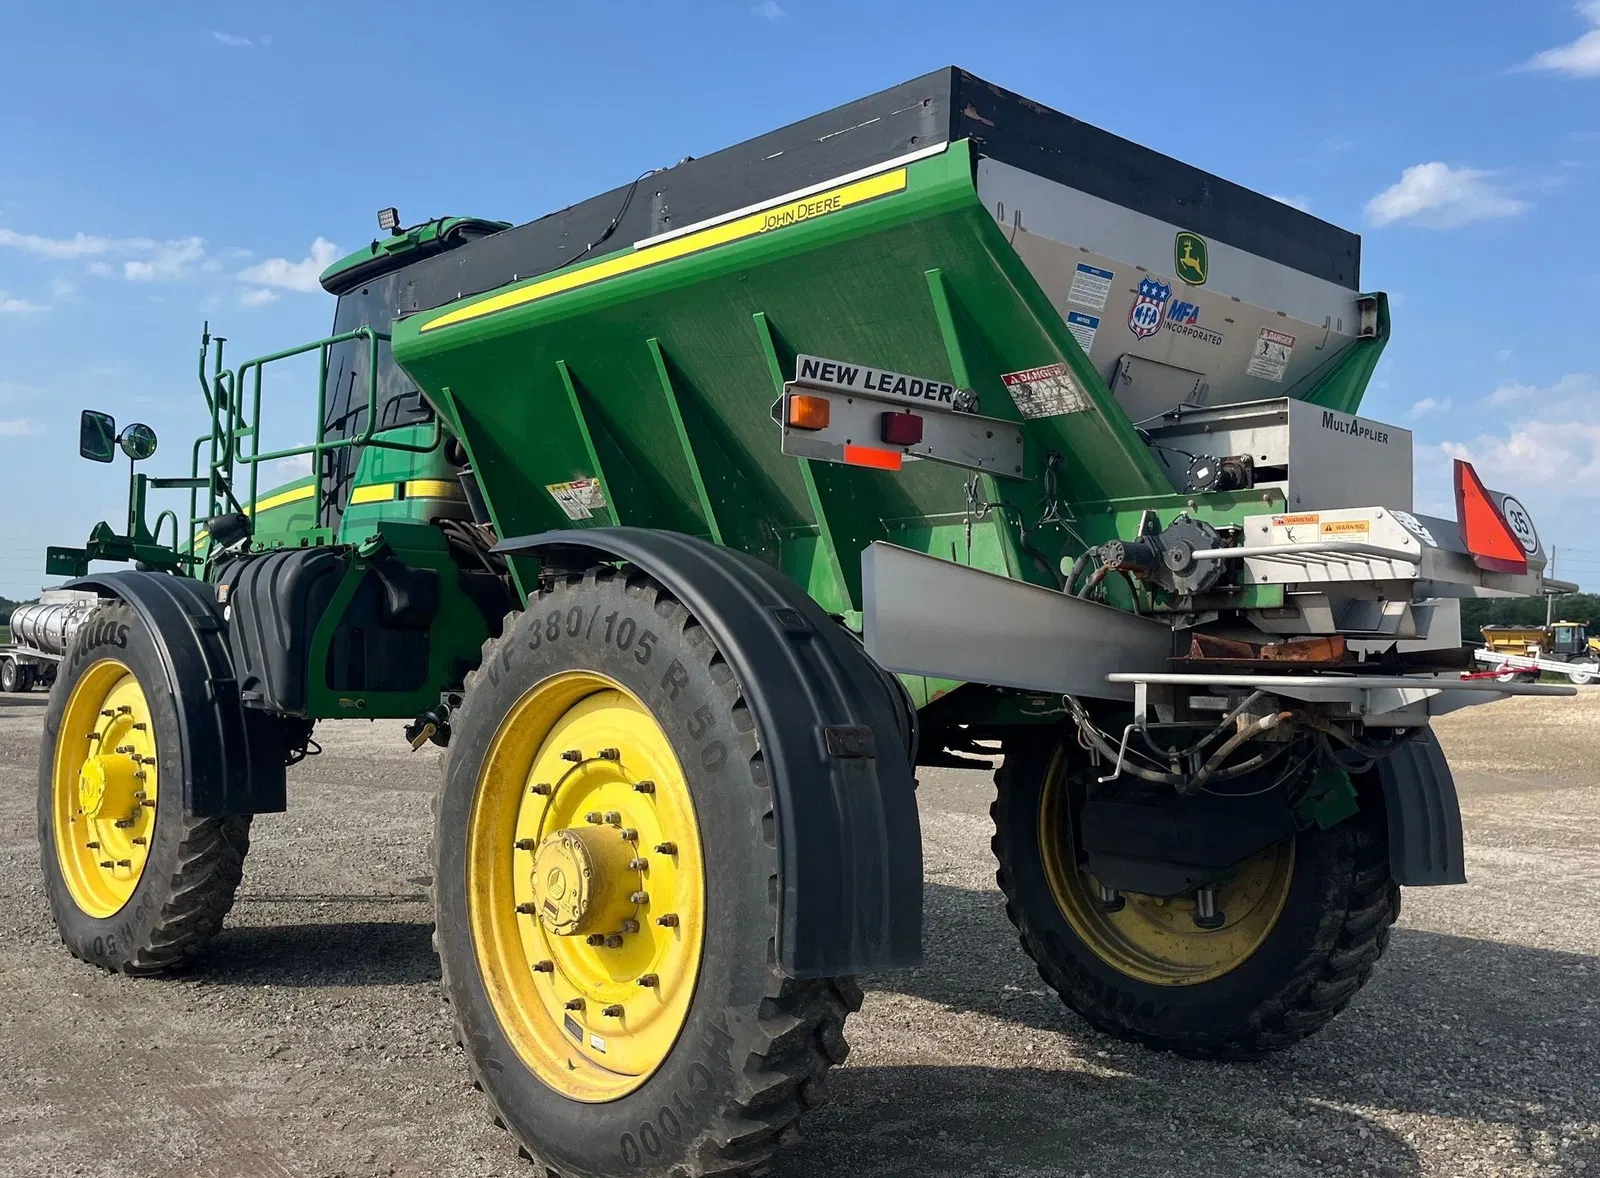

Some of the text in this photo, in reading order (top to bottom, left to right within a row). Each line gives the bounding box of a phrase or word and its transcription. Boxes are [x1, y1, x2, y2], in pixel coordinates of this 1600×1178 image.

[760, 195, 841, 231] JOHN DEERE
[1166, 299, 1200, 325] MFA
[1162, 320, 1223, 346] INCORPORATED
[1268, 332, 1296, 347] DANGER
[800, 359, 955, 403] NEW LEADER
[1019, 366, 1062, 383] DANGER
[1286, 516, 1315, 524] WARNING
[1336, 524, 1365, 532] WARNING
[1509, 509, 1530, 536] 35
[527, 604, 659, 666] 380/105
[660, 657, 689, 702] R
[686, 703, 729, 774] 50
[619, 1088, 698, 1169] 1000
